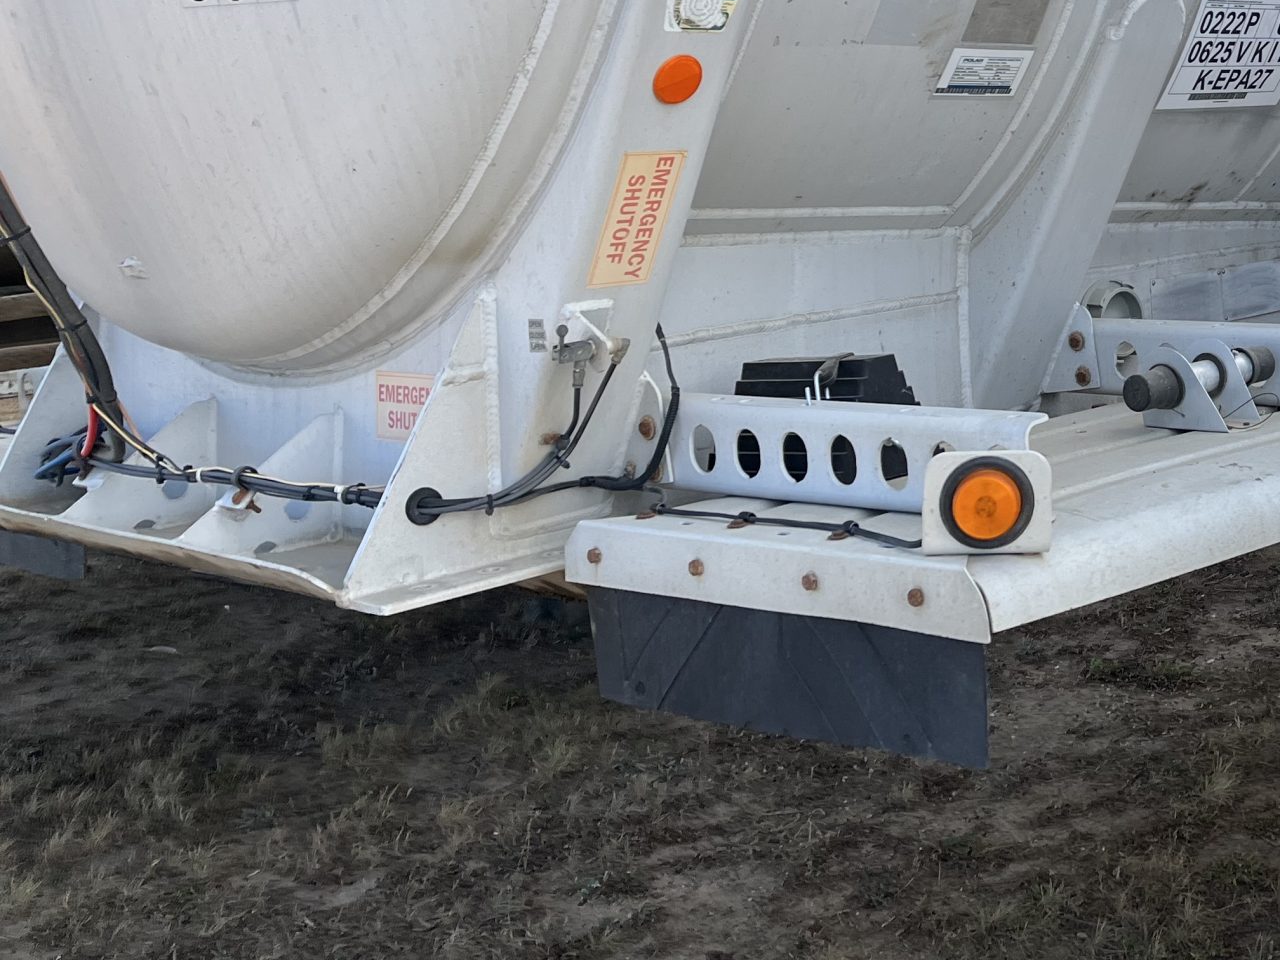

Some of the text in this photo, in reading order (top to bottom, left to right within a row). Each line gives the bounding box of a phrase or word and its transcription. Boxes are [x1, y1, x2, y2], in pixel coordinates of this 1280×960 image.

[1199, 10, 1261, 35] 0222P
[1191, 69, 1275, 91] K-EPA27
[605, 174, 646, 264] SHUTOFF
[623, 156, 676, 278] EMERGENCY
